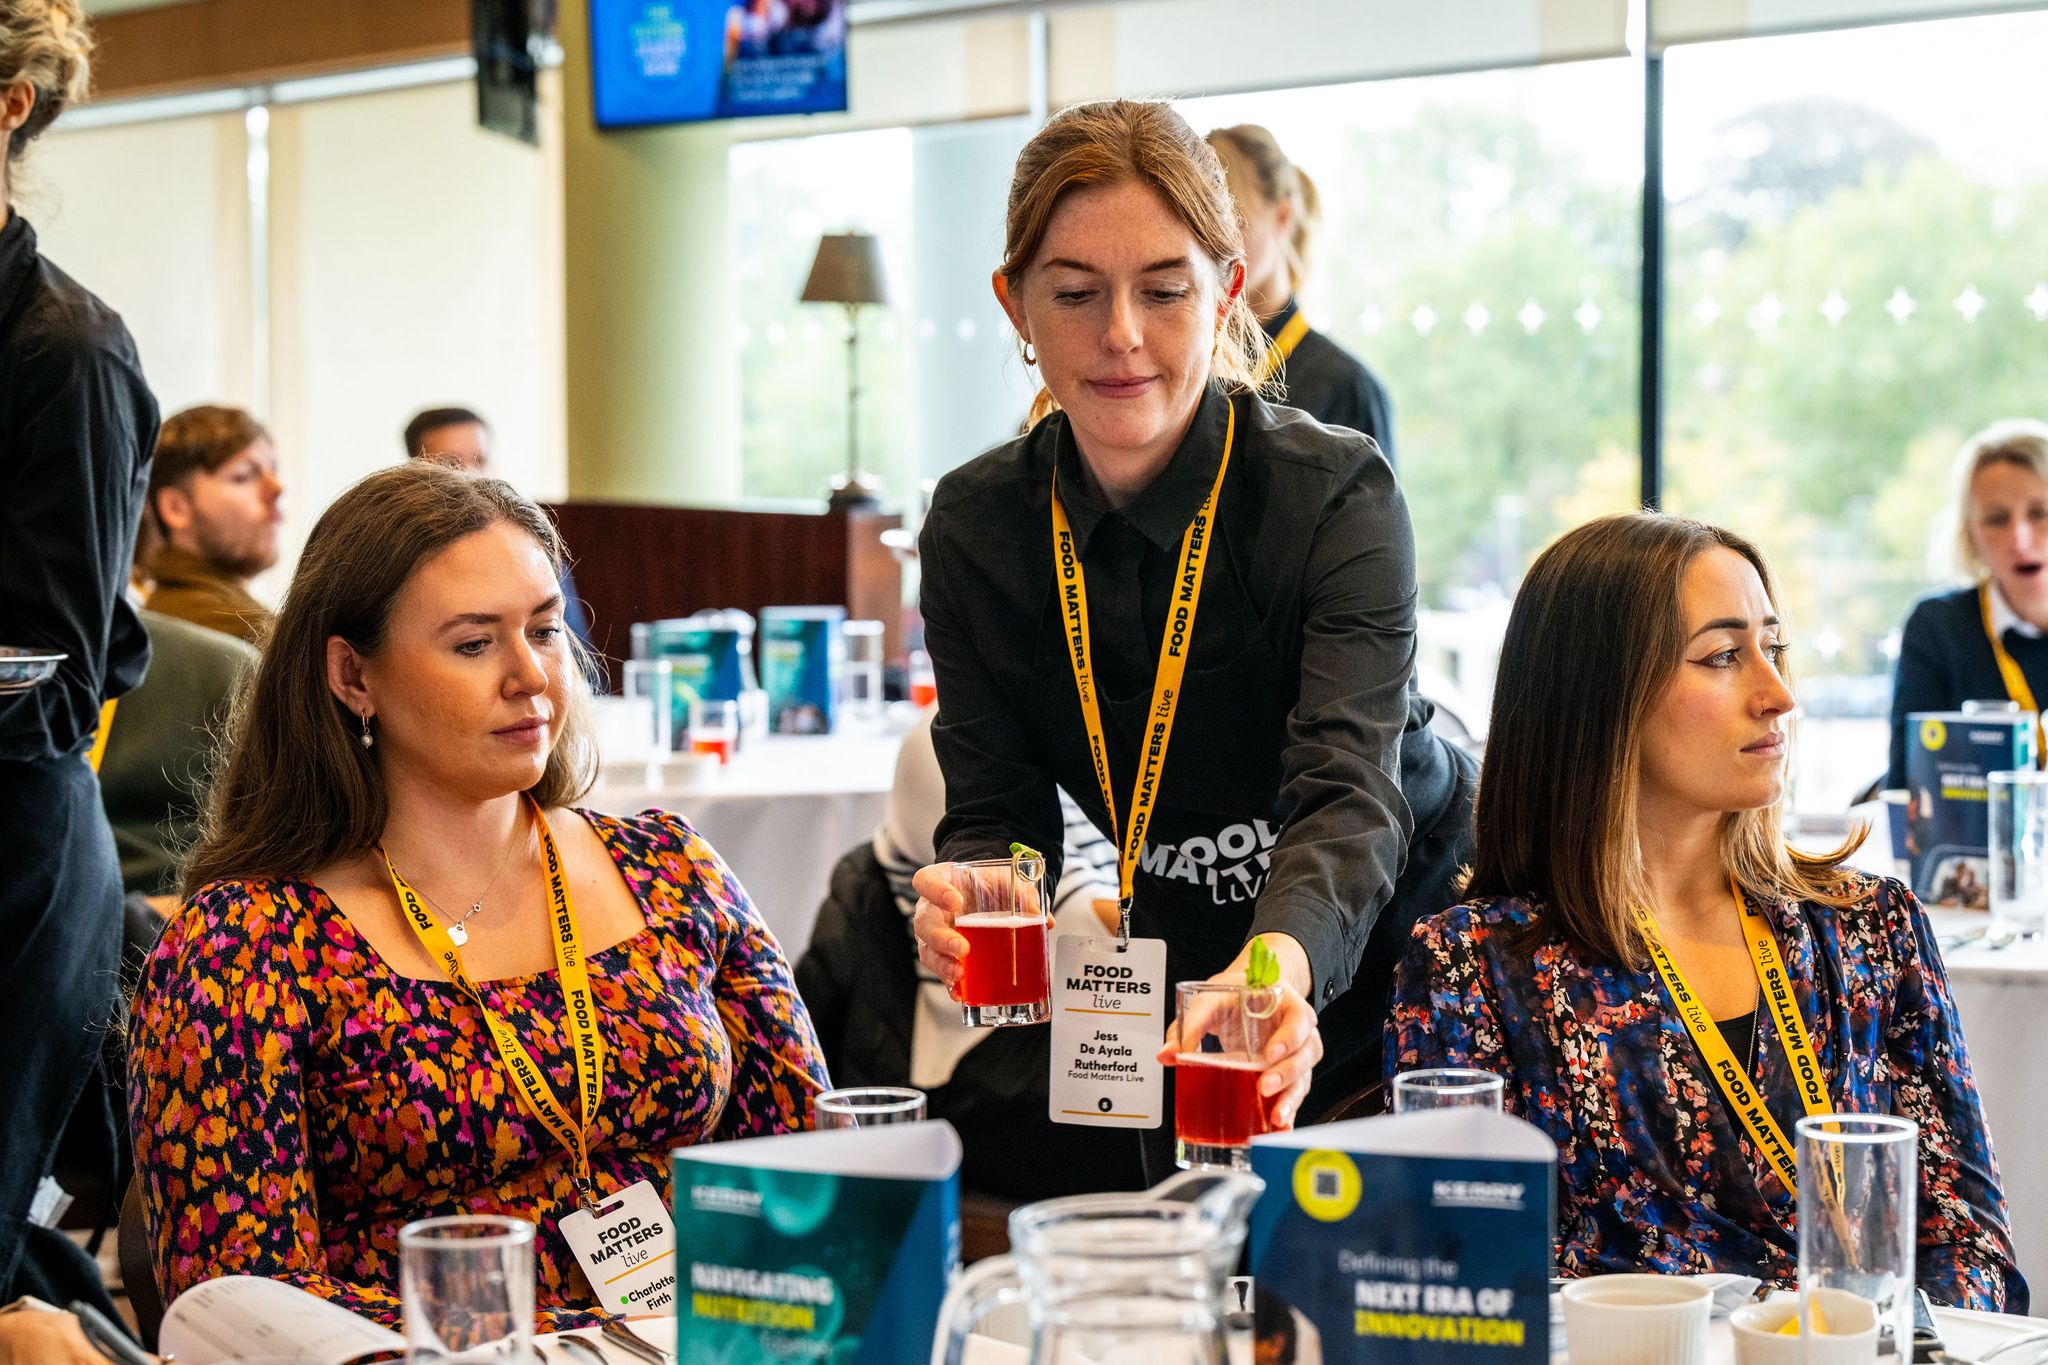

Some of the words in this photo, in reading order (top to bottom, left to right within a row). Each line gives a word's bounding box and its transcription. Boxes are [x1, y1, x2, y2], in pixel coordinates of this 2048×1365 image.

[1059, 531, 1076, 580] FOOD
[1168, 606, 1189, 658] FOOD
[1180, 514, 1207, 603] MATTERS
[1065, 584, 1086, 670] MATTERS
[1078, 674, 1090, 703] live
[1092, 735, 1106, 785] FOOD
[1128, 812, 1146, 861] FOOD
[1139, 721, 1167, 808] MATTERS
[1155, 688, 1174, 718] live
[543, 833, 558, 873] FOOD
[405, 891, 434, 931] FOOD
[550, 874, 574, 943] MATTERS
[444, 950, 460, 979] live
[562, 943, 577, 968] live
[1083, 964, 1133, 979] FOOD
[1757, 939, 1774, 967] live
[1066, 977, 1152, 995] MATTERS
[1092, 994, 1122, 1010] live
[571, 988, 591, 1029] FOOD
[1685, 1005, 1707, 1033] live
[1765, 967, 1804, 1051] MATTERS
[497, 1029, 517, 1056] live
[1079, 1043, 1096, 1055] De
[1097, 1044, 1133, 1058] Ayala
[1093, 1030, 1119, 1042] Jess
[580, 1033, 599, 1119] MATTERS
[1067, 1070, 1089, 1080] Food
[1090, 1072, 1124, 1083] Matters
[1126, 1074, 1145, 1083] Live
[1074, 1058, 1138, 1073] Rutherford
[1716, 1059, 1751, 1106] FOOD
[1796, 1054, 1823, 1105] FOOD
[510, 1056, 566, 1129] MATTERS
[589, 1222, 664, 1265] MATTERS
[597, 1216, 642, 1245] FOOD
[620, 1249, 649, 1268] live
[1337, 1249, 1420, 1280] Defining
[1422, 1256, 1460, 1279] the
[628, 1274, 676, 1303] Charlotte
[646, 1292, 673, 1311] Firth
[690, 1261, 835, 1306] NAVIGATING
[1354, 1279, 1420, 1311] NEXT
[1422, 1284, 1476, 1316] ERA
[1475, 1287, 1515, 1318] OF
[691, 1291, 816, 1332] NUTRITION
[1353, 1308, 1526, 1348] INNOVATION
